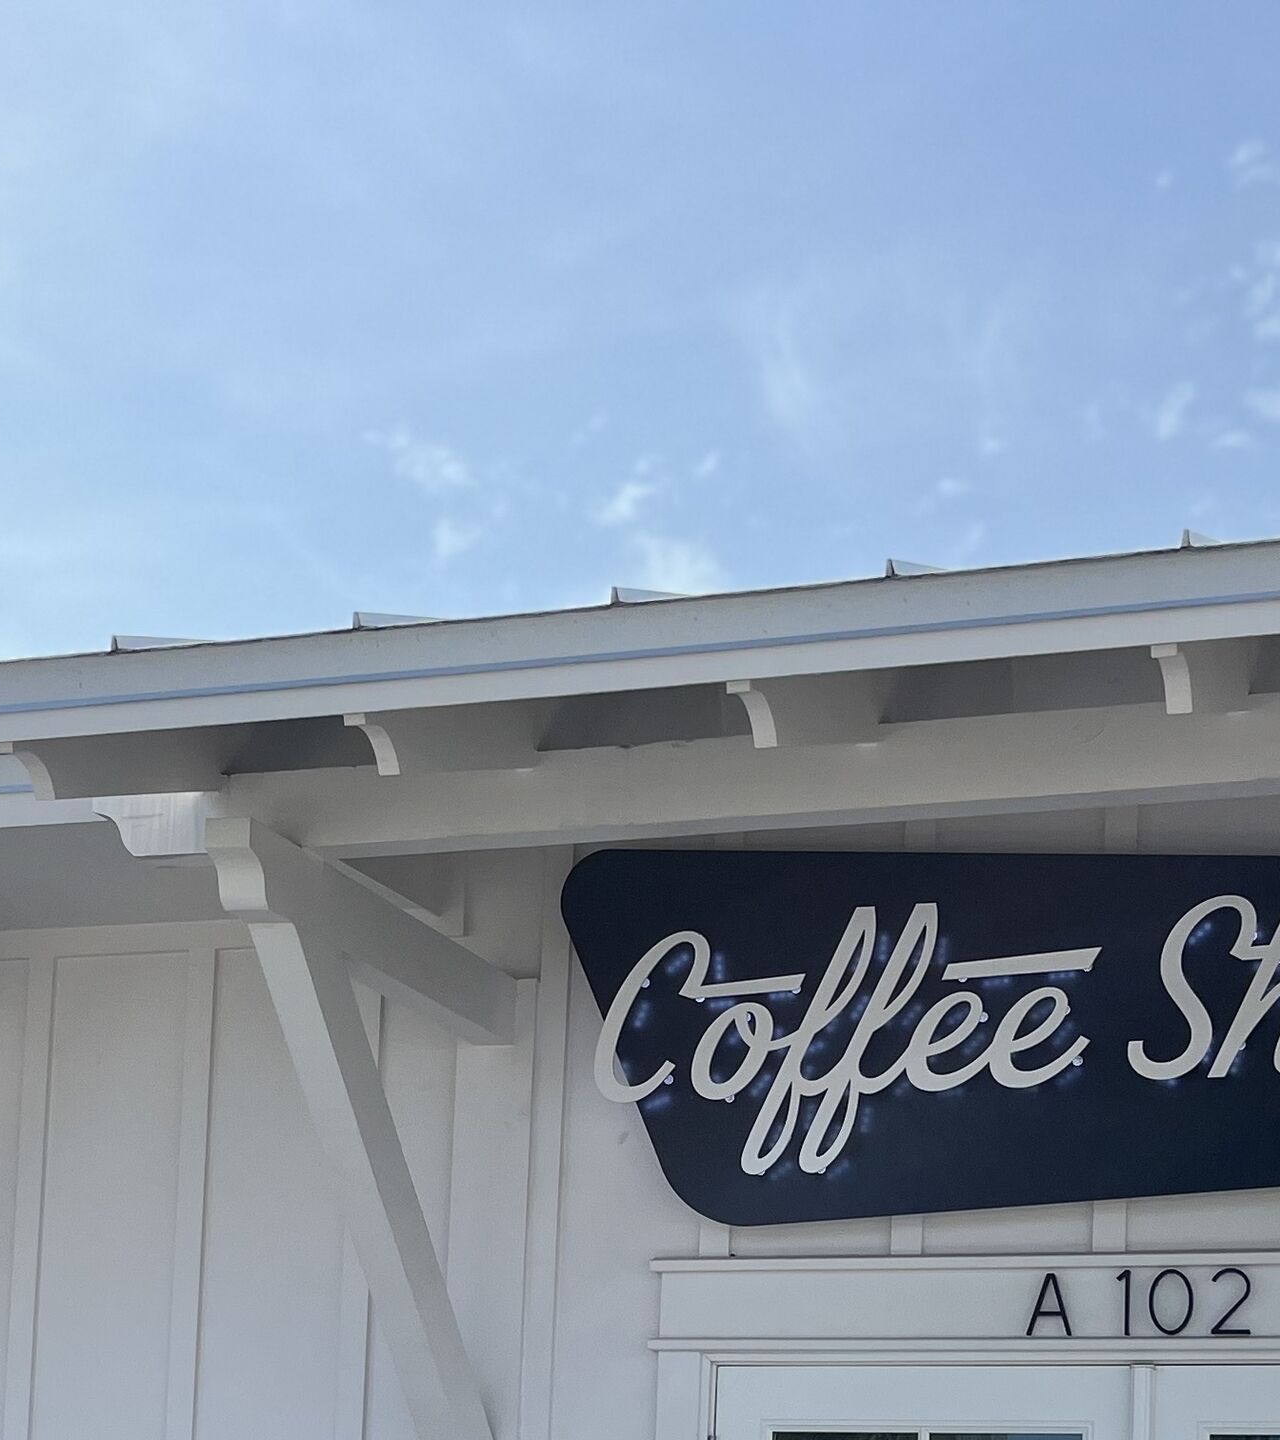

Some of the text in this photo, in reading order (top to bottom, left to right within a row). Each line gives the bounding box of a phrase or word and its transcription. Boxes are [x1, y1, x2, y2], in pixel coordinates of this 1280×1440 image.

[594, 902, 1103, 1176] Coffee
[1025, 1267, 1252, 1337] A 102
